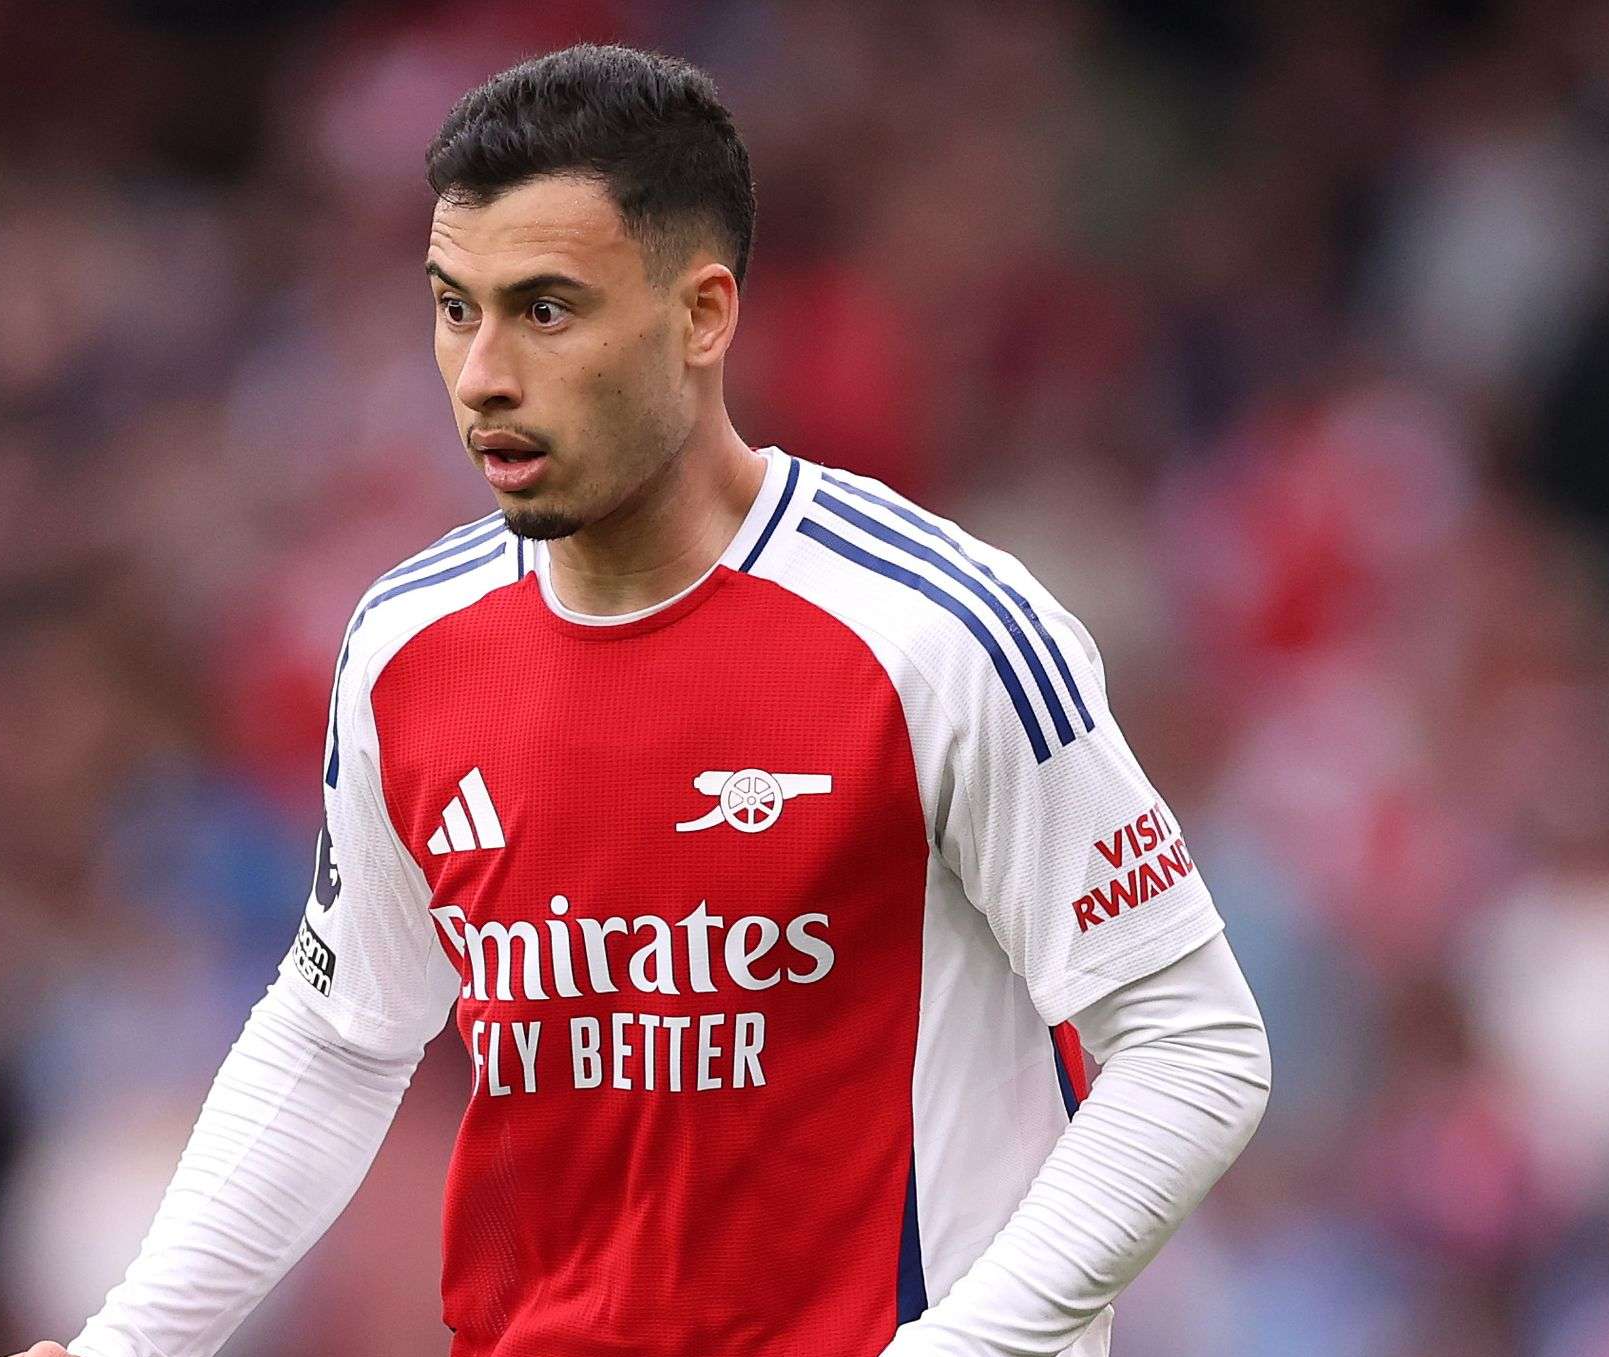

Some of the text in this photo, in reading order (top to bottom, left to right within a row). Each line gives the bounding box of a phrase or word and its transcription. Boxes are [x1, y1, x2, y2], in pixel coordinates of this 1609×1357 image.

[1072, 838, 1194, 934] RWAND
[429, 895, 835, 1001] Emirates
[472, 1011, 767, 1098] FLY BETTER
